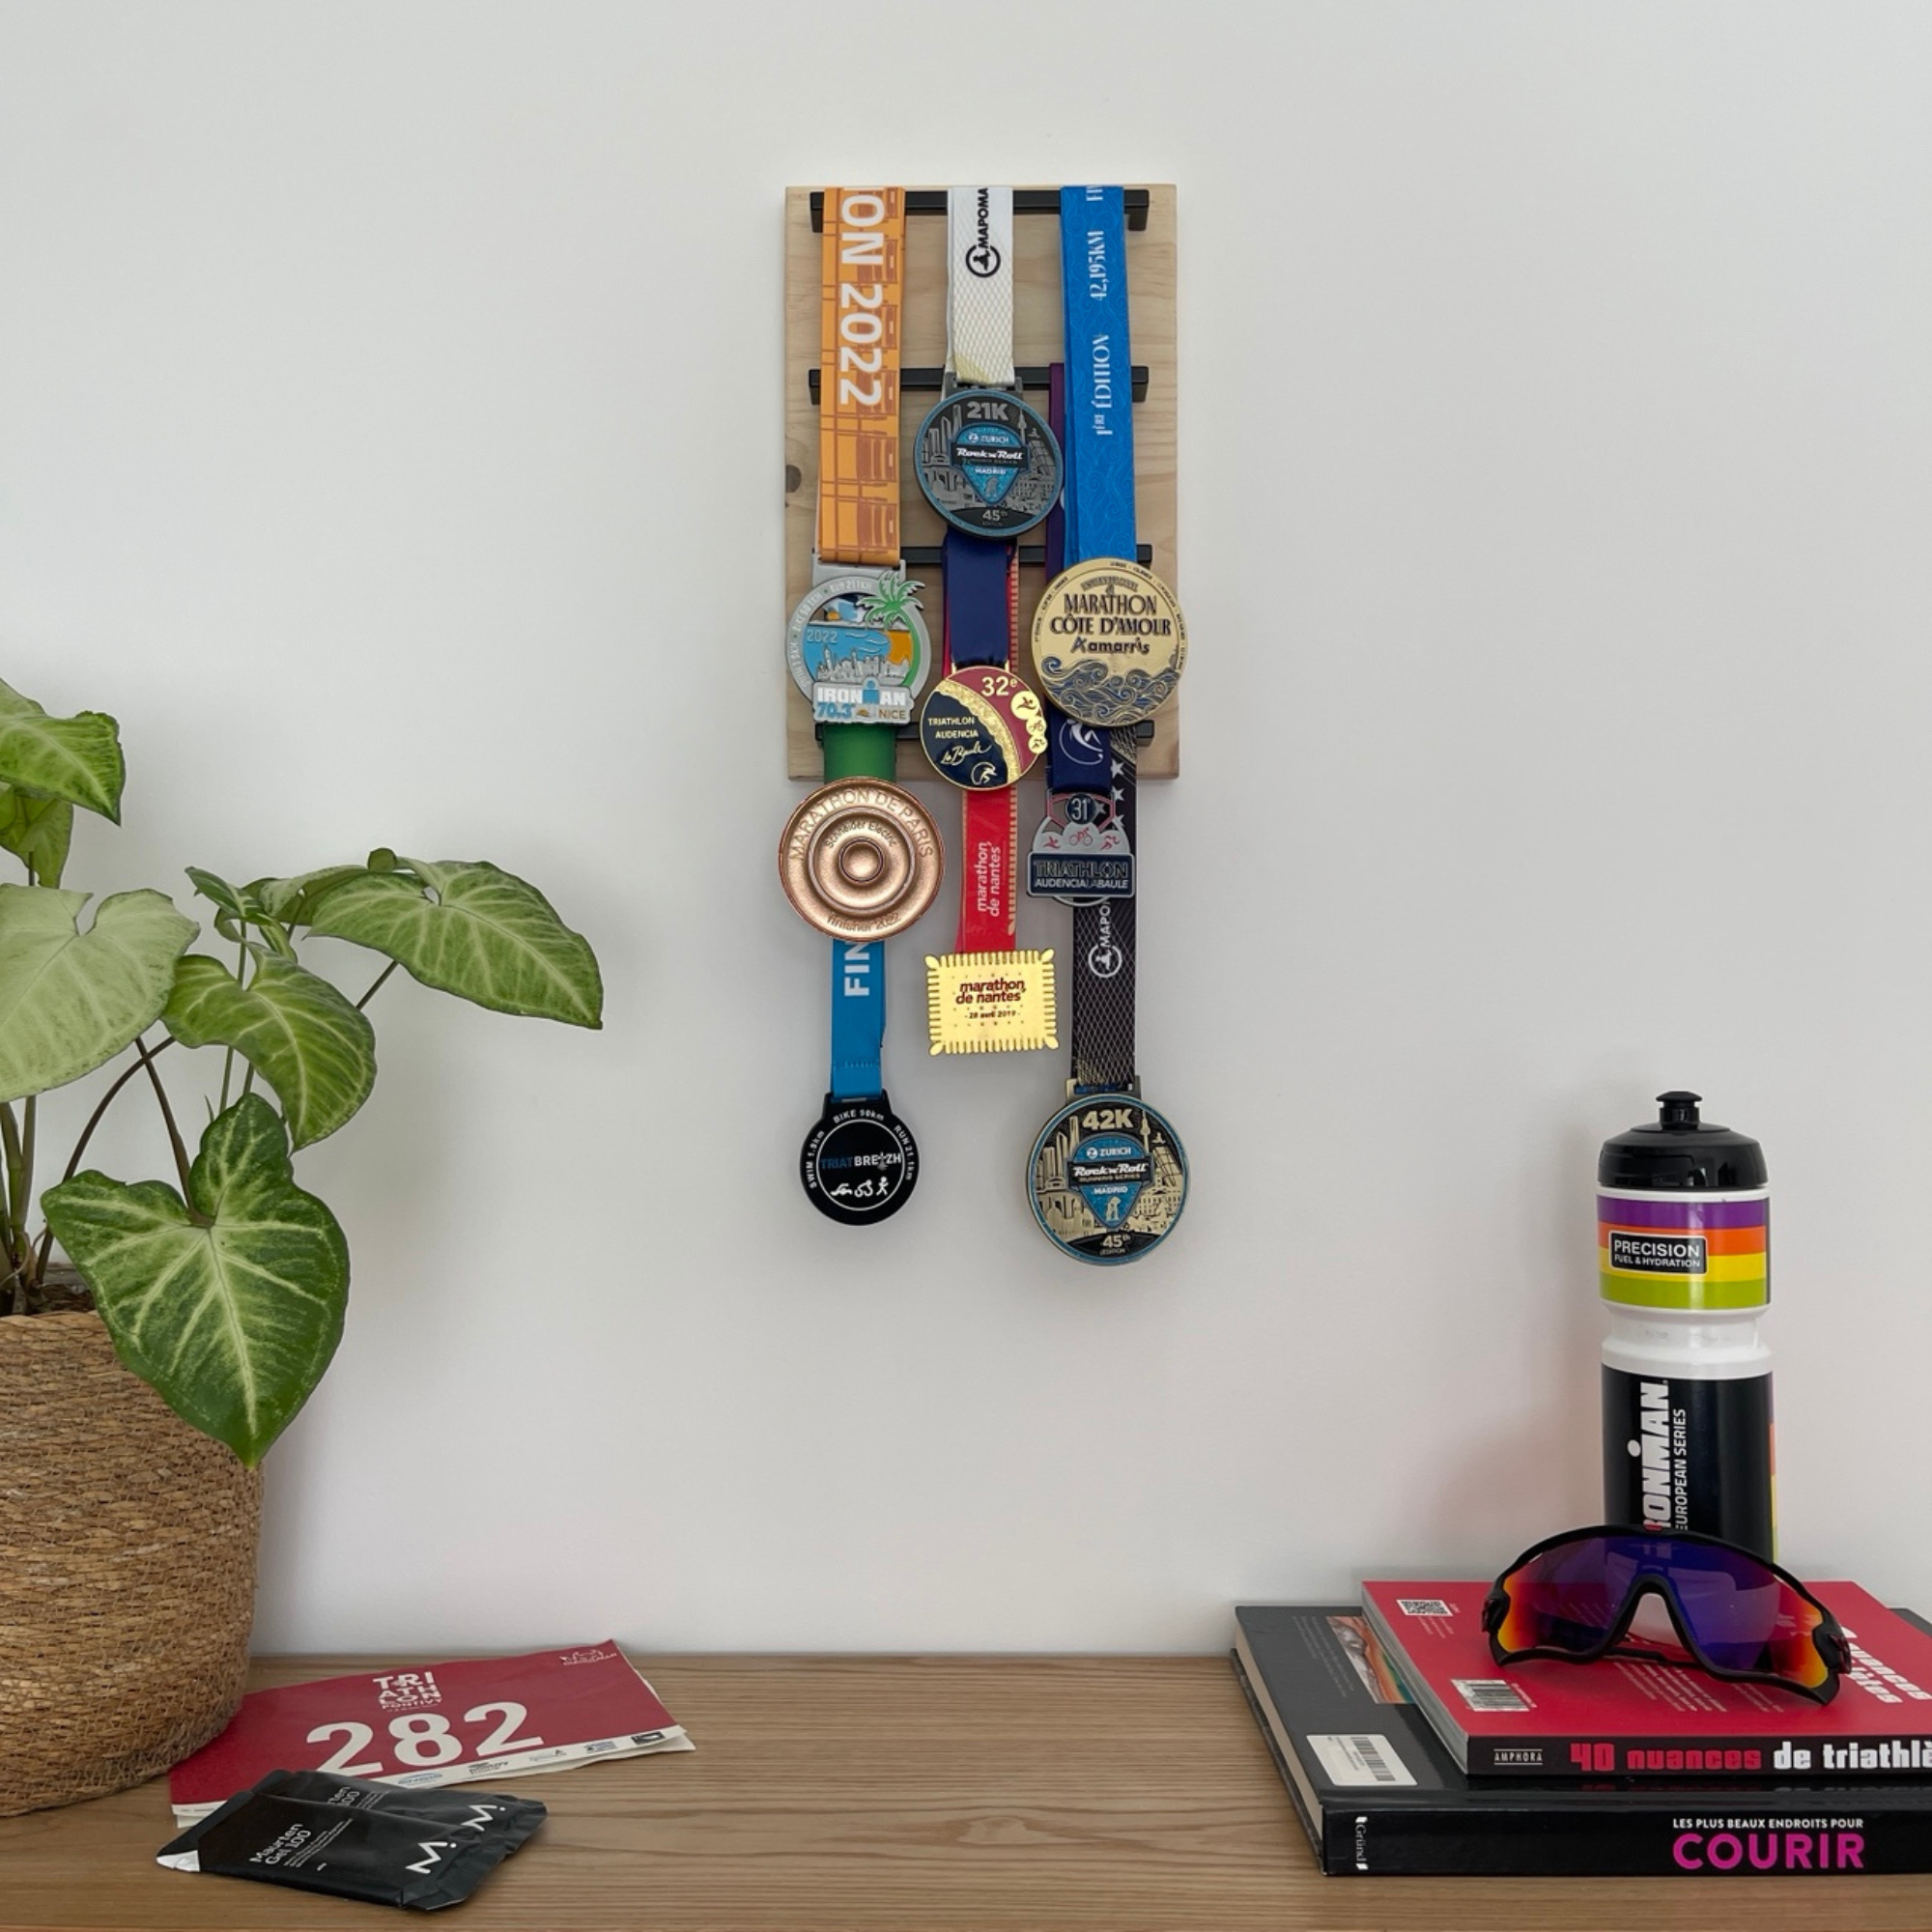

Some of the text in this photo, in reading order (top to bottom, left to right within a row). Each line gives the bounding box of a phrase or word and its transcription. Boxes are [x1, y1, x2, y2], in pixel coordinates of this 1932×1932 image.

[977, 186, 989, 249] MAPOMA
[1087, 230, 1110, 301] 42,195KM
[839, 187, 885, 406] ON 2022
[1091, 332, 1112, 409] ÉDITION
[967, 400, 1009, 421] 21K
[1064, 593, 1157, 616] MARATHON
[807, 629, 838, 643] 2022
[1051, 614, 1172, 636] CÔTE D'AMOUR
[878, 708, 906, 720] NICE
[928, 717, 976, 725] TRIATHLON
[935, 729, 980, 739] AUDENCIA
[789, 787, 933, 860] MARATHON DE PARIS
[1034, 860, 1128, 878] TRIATHLON
[987, 846, 1001, 917] de nantes
[1099, 900, 1111, 947] MAPO
[955, 991, 1021, 1005] de nantes
[833, 1109, 857, 1124] BIKE
[1082, 1109, 1134, 1130] 42K
[1099, 1148, 1131, 1157] ZURICH
[806, 1161, 817, 1189] SWIM
[1094, 1185, 1128, 1195] MADRID
[1614, 1239, 1700, 1259] PRECISION
[1614, 1254, 1700, 1267] FUEL & HYDRATION
[1672, 1408, 1688, 1456] SERIES
[306, 1701, 544, 1776] 282
[1494, 1751, 1543, 1763] AMPHORA
[1571, 1743, 1615, 1772] 40
[1627, 1749, 1762, 1771] nuances
[1774, 1742, 1811, 1770] de
[1673, 1819, 1863, 1829] LES PLUS BEAUX ENDROITS POUR
[249, 1823, 303, 1862] Maurten
[265, 1830, 311, 1864] Gel 100
[1672, 1833, 1864, 1870] COURIR
